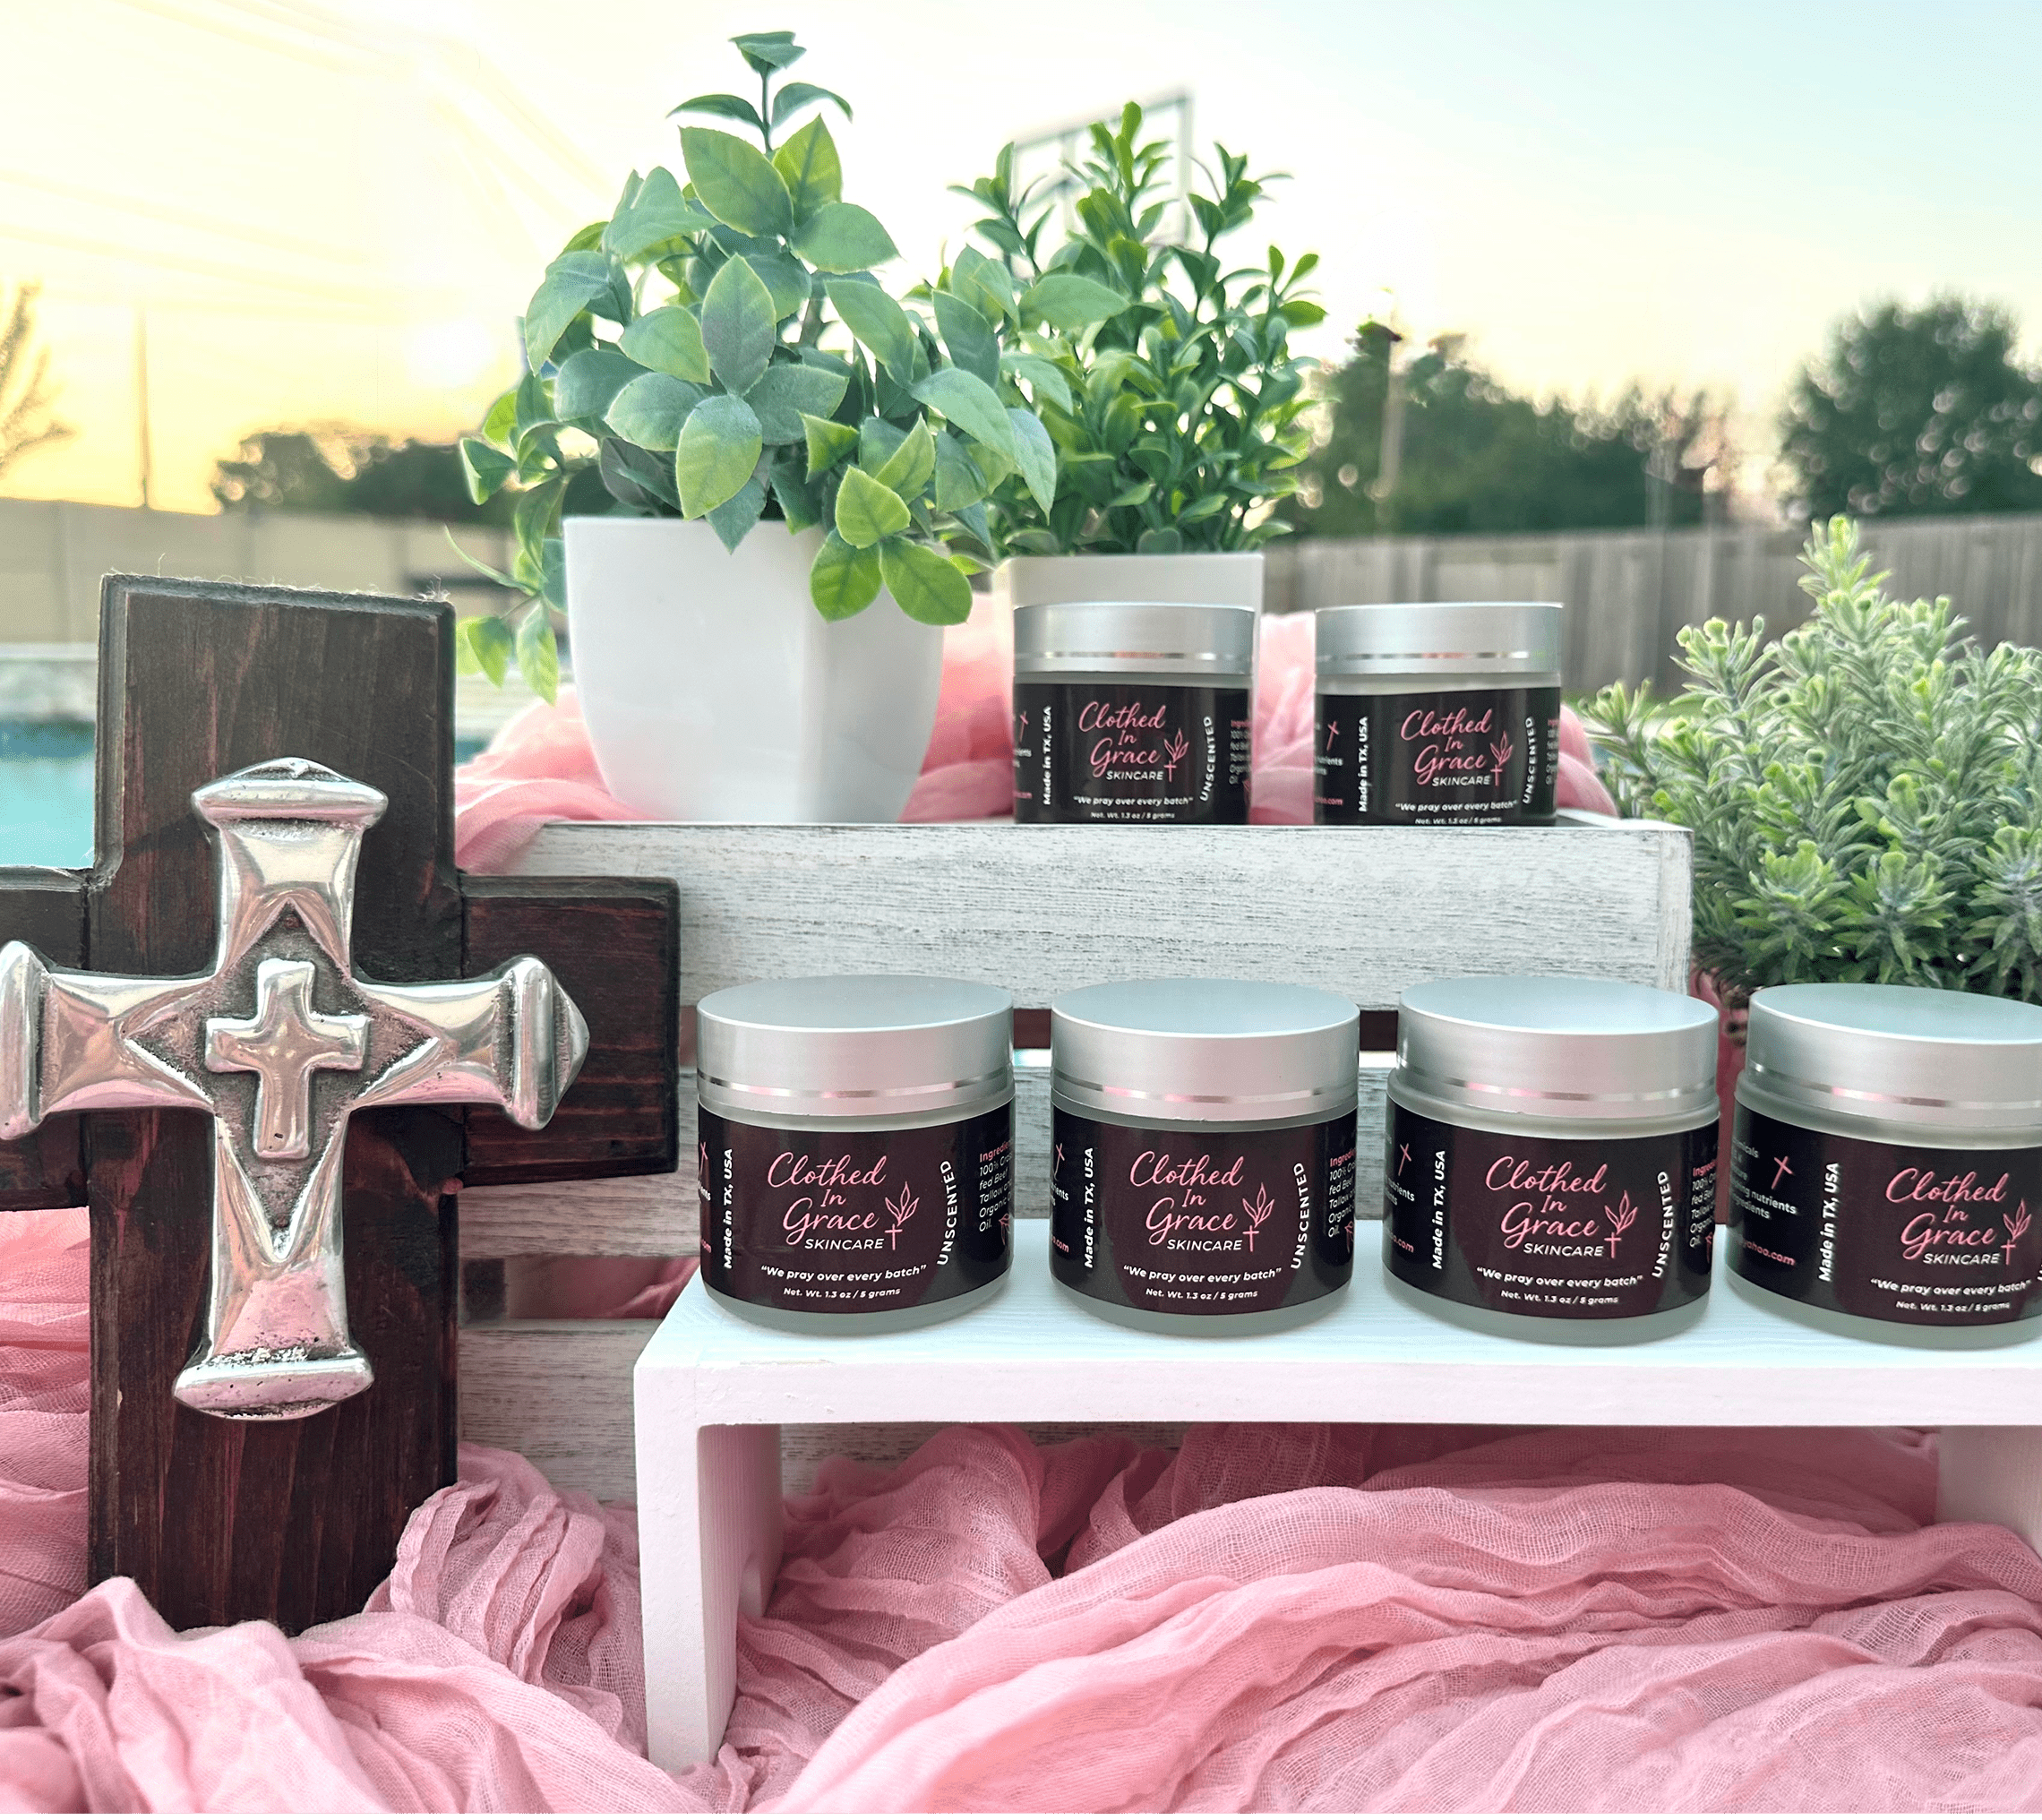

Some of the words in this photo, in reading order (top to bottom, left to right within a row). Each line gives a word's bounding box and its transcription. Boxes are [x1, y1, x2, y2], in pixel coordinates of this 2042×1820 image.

[1078, 701, 1166, 732] Clothed
[1400, 708, 1492, 741] Clothed
[1118, 730, 1137, 745] In
[1359, 717, 1368, 742] USA
[1445, 736, 1463, 752] In
[1042, 756, 1051, 768] in
[1090, 737, 1161, 777] Grace
[1199, 717, 1215, 802] UNSCENTED
[1413, 745, 1486, 786] Grace
[1523, 717, 1537, 803] UNSCENTED
[1106, 771, 1163, 780] SKINCARE
[1358, 765, 1368, 777] in
[1432, 776, 1491, 786] SKINCARE
[1042, 770, 1051, 804] Made
[1359, 778, 1368, 811] Made
[1094, 798, 1113, 806] pray
[1137, 798, 1162, 806] every
[1418, 804, 1440, 812] pray
[1442, 803, 1463, 811] over
[1464, 803, 1489, 811] every
[724, 1149, 733, 1180] USA
[767, 1151, 887, 1188] Clothed
[1085, 1148, 1093, 1178] USA
[1129, 1150, 1245, 1188] Clothed
[1435, 1151, 1445, 1180] USA
[979, 1176, 994, 1190] fed
[1485, 1155, 1608, 1193] Clothed
[1824, 1163, 1840, 1193] USA
[724, 1184, 734, 1206] TX,
[1085, 1183, 1095, 1205] TX,
[1434, 1185, 1446, 1206] TX,
[1885, 1167, 2009, 1203] Clothed
[819, 1189, 846, 1207] In
[1181, 1189, 1205, 1208] In
[1540, 1195, 1567, 1213] In
[1752, 1190, 1797, 1215] nutrients
[1823, 1198, 1840, 1219] TX,
[723, 1210, 732, 1225] in
[782, 1197, 880, 1245] Grace
[937, 1160, 958, 1266] UNSCENTED
[1084, 1209, 1093, 1223] in
[1145, 1198, 1238, 1245] Grace
[1291, 1163, 1309, 1269] UNSCENTED
[1432, 1211, 1443, 1225] in
[1943, 1205, 1969, 1223] In
[1500, 1202, 1600, 1249] Grace
[1652, 1171, 1674, 1278] UNSCENTED
[1820, 1223, 1835, 1238] in
[804, 1238, 884, 1250] SKINCARE
[1084, 1226, 1093, 1267] Made
[1167, 1239, 1243, 1251] SKINCARE
[1900, 1212, 1996, 1260] Grace
[724, 1228, 732, 1268] Made
[1432, 1228, 1443, 1269] Made
[1523, 1242, 1604, 1258] SKINCARE
[1923, 1252, 2001, 1265] SKINCARE
[1819, 1240, 1834, 1282] Made
[786, 1270, 814, 1282] pray
[817, 1273, 845, 1281] over
[846, 1272, 882, 1282] every
[1148, 1270, 1176, 1283] pray
[1179, 1274, 1205, 1283] over
[1207, 1274, 1240, 1283] every
[1504, 1273, 1533, 1286] pray
[1536, 1277, 1565, 1286] over
[1566, 1278, 1601, 1290] every
[783, 1287, 802, 1296] Net.
[868, 1288, 901, 1299] grams
[1145, 1288, 1163, 1297] Net.
[1167, 1291, 1183, 1299] Wt.
[1220, 1292, 1225, 1300] 5
[1228, 1291, 1257, 1300] grams
[1501, 1290, 1521, 1300] Net.
[1523, 1293, 1540, 1301] Wt.
[1544, 1295, 1557, 1303] 1.3
[1588, 1297, 1618, 1305] grams
[1900, 1284, 1931, 1296] pray
[1934, 1286, 1961, 1294] over
[1963, 1285, 1996, 1296] every
[1982, 1302, 2011, 1312] grams
